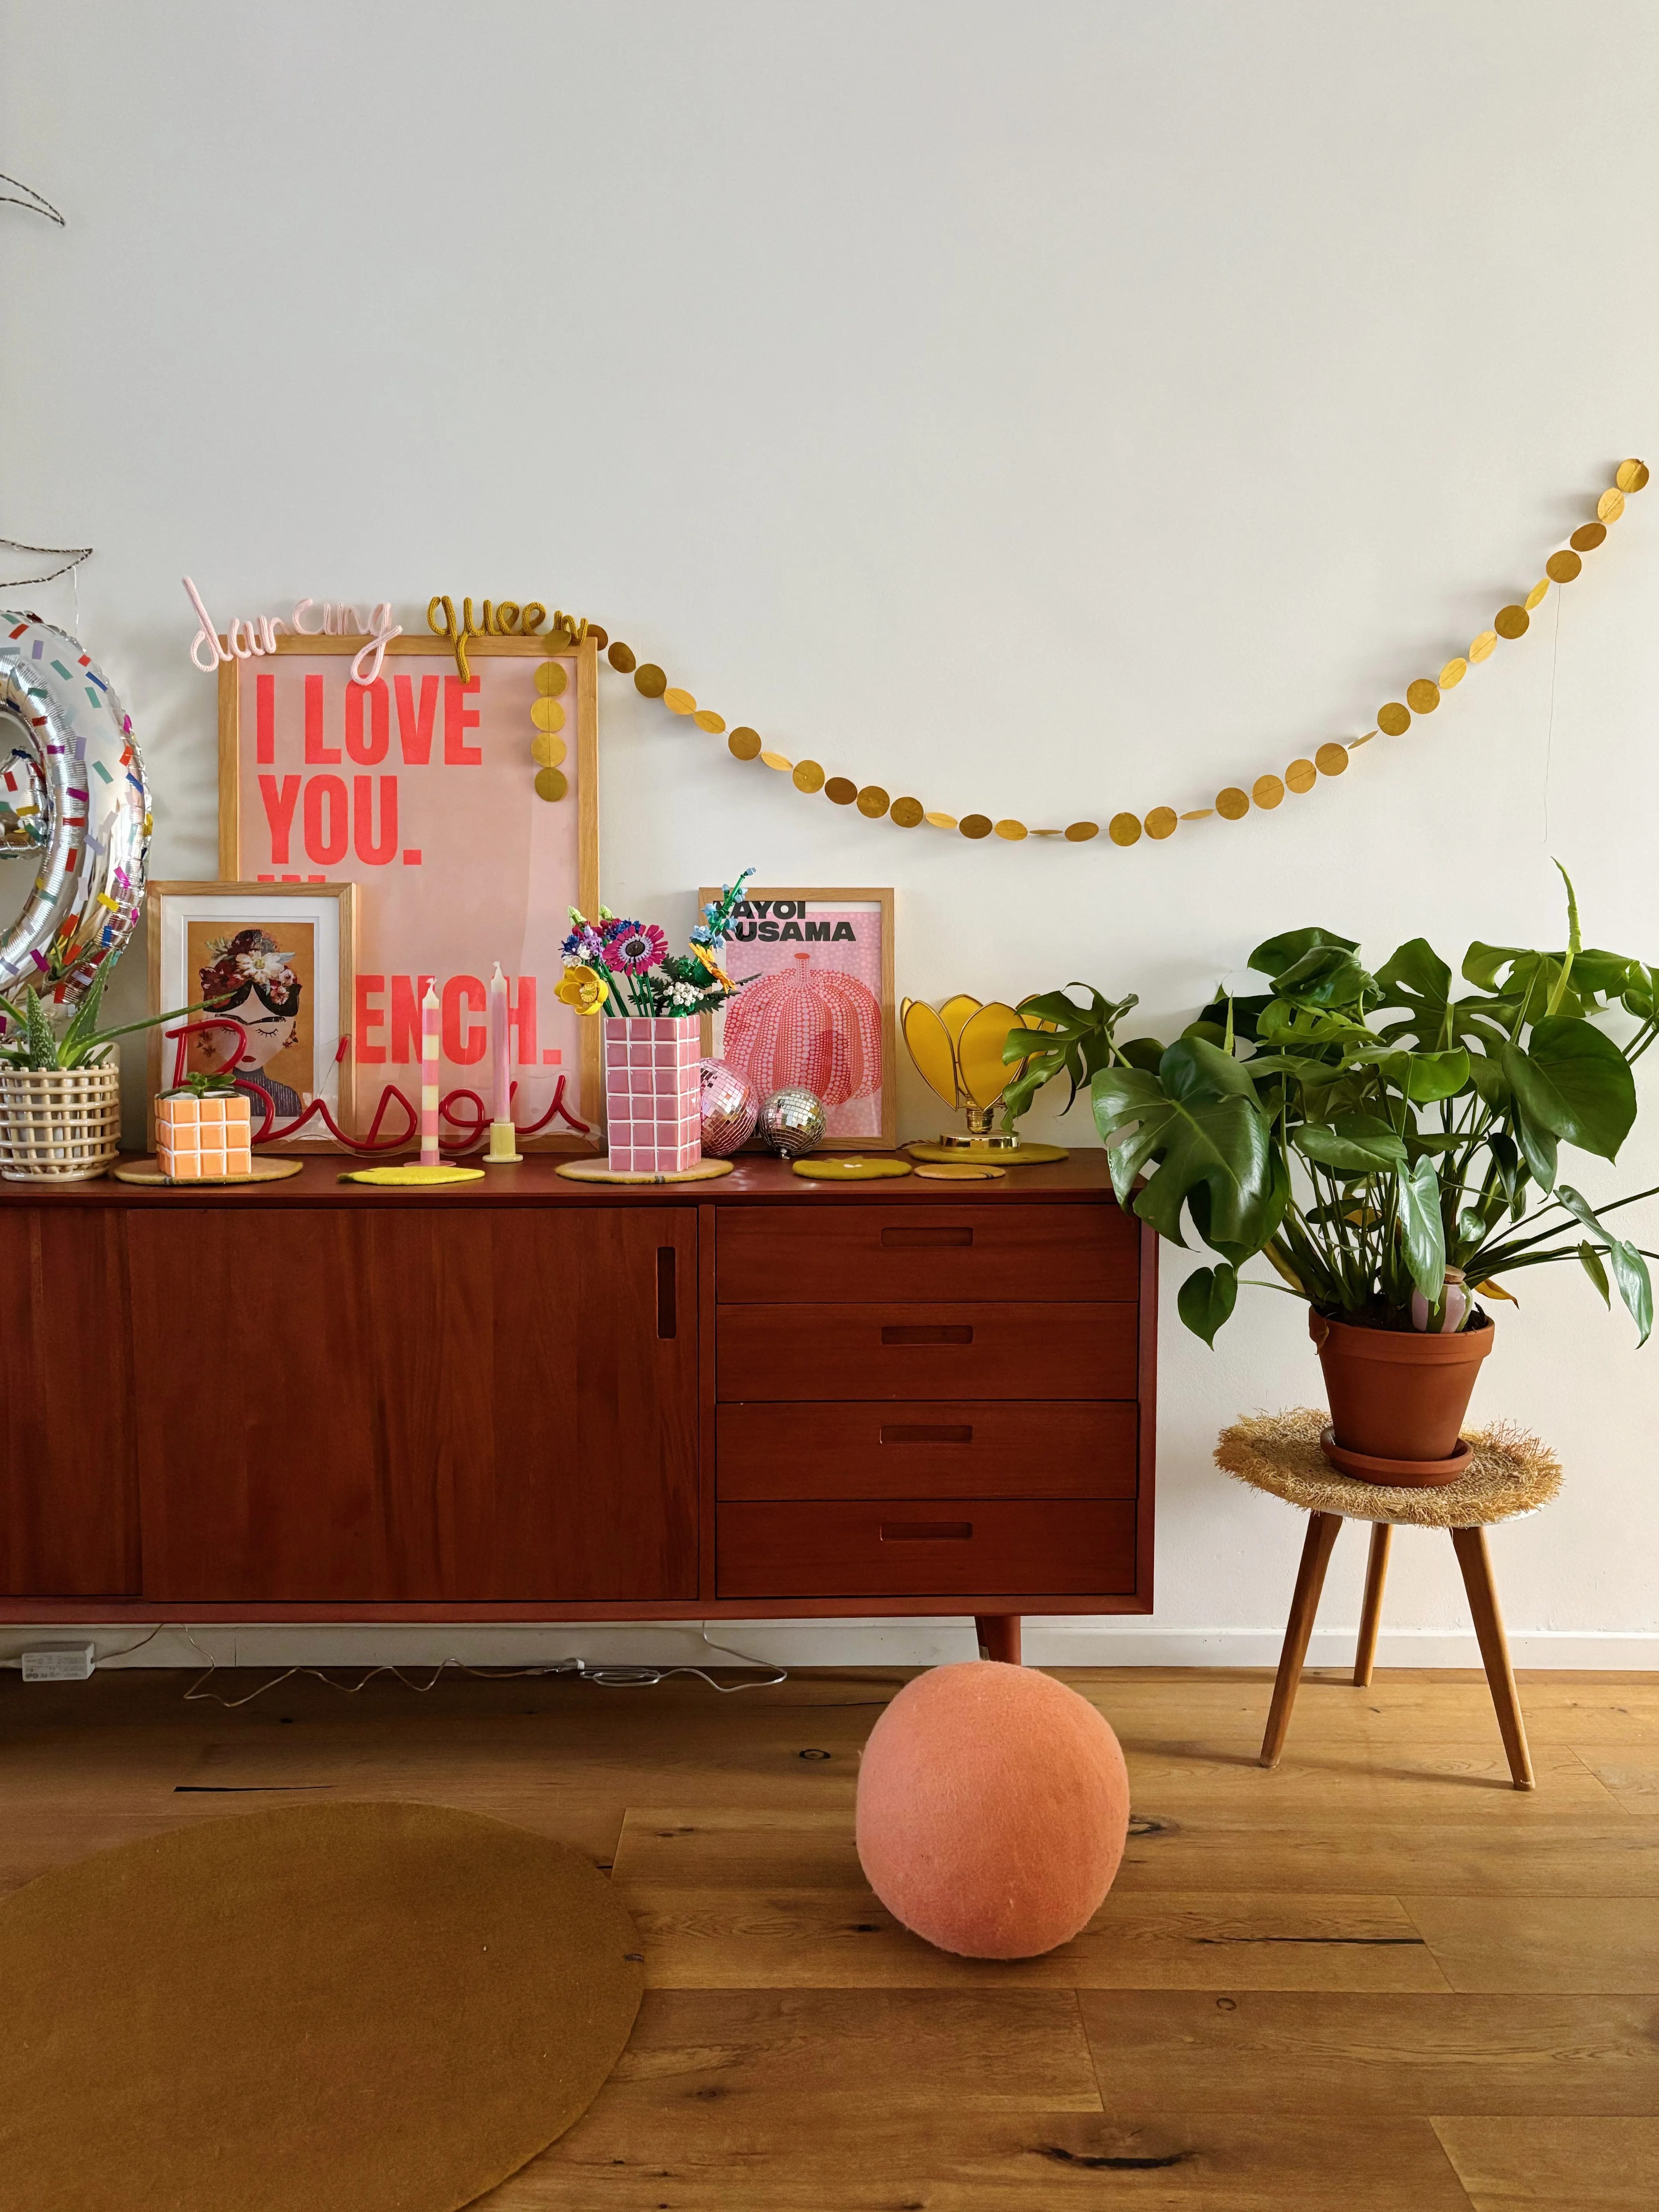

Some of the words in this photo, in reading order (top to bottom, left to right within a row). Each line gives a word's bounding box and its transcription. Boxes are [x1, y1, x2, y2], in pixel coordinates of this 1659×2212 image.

[181, 576, 404, 686] dancing
[427, 595, 588, 684] queen
[257, 675, 275, 764] I
[305, 675, 482, 766] LOVE
[258, 775, 422, 866] YOU.
[355, 975, 562, 1065] ENCH.
